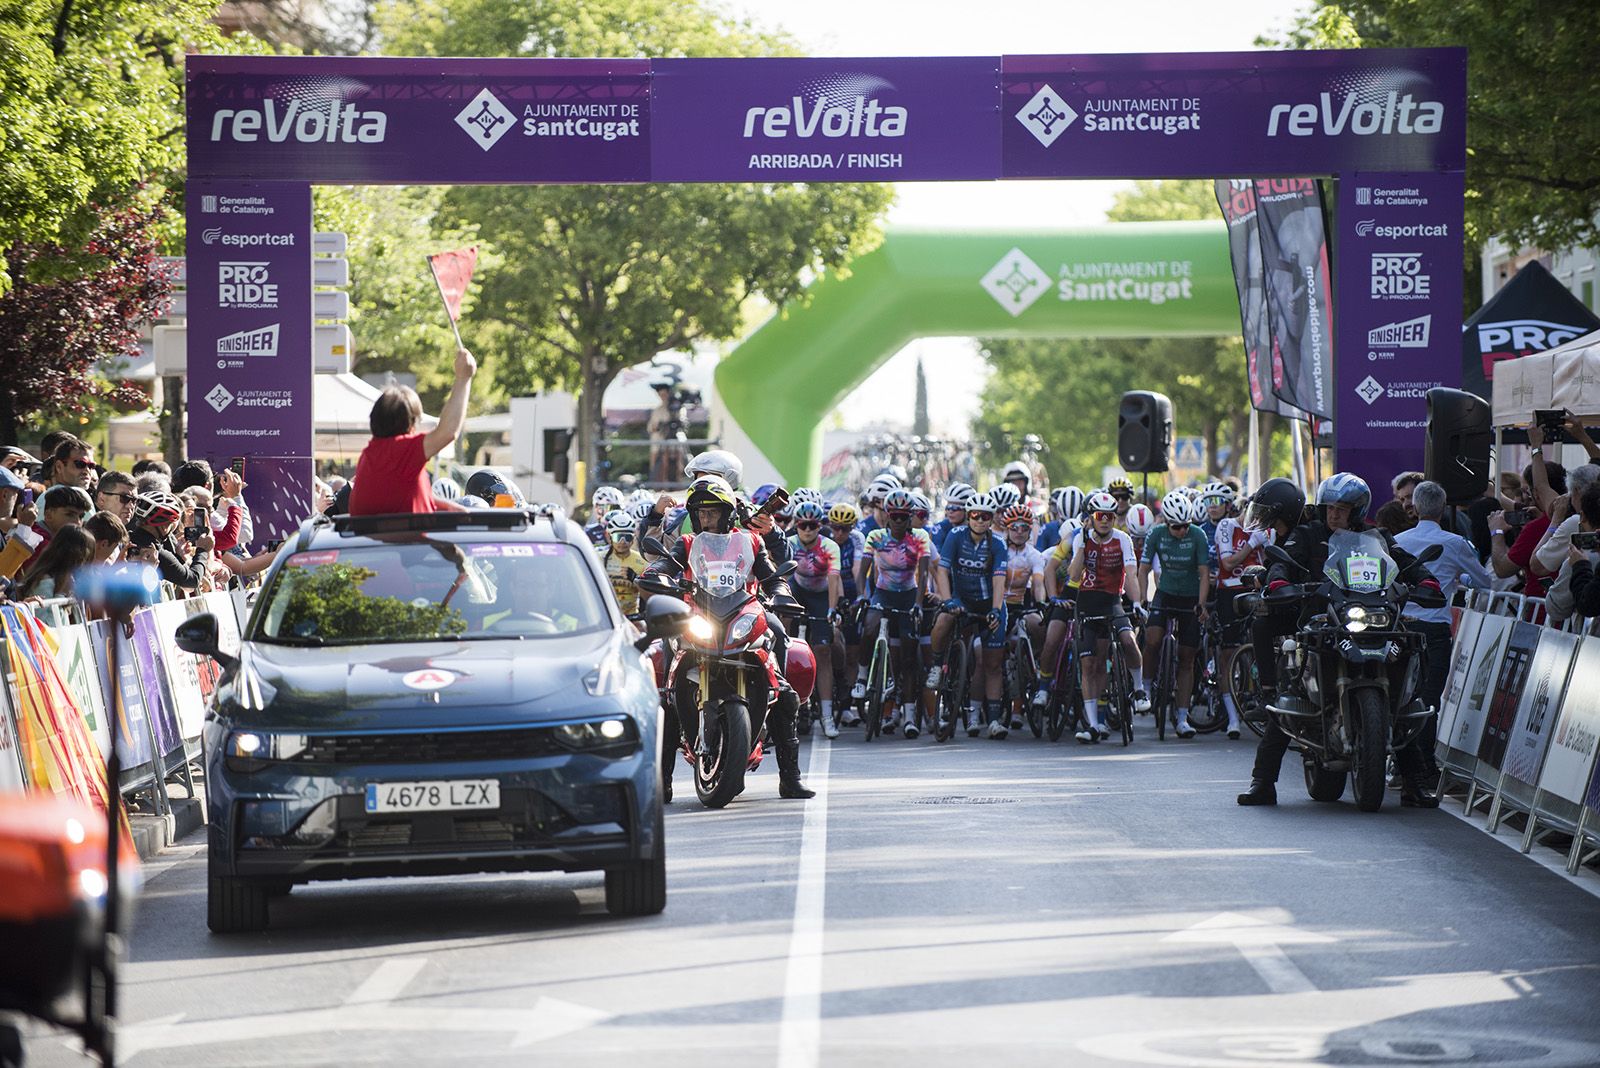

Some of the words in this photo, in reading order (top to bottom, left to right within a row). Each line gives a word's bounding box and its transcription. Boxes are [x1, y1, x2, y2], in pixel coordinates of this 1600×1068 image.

[523, 104, 617, 117] AJUNTAMENT
[621, 104, 639, 116] DE
[1084, 98, 1178, 112] AJUNTAMENT
[1182, 98, 1200, 110] DE
[210, 99, 387, 143] reVolta
[743, 96, 907, 138] reVolta
[1084, 112, 1200, 135] SantCugat
[1267, 92, 1444, 137] reVolta
[523, 117, 639, 142] SantCugat
[748, 154, 834, 169] ARRIBADA
[848, 153, 903, 168] FINISH
[220, 196, 265, 205] Generalitat
[1374, 188, 1419, 196] Generalitat
[232, 205, 274, 216] Catalunya
[1374, 197, 1384, 205] de
[1386, 197, 1428, 207] Catalunya
[221, 233, 295, 248] esportcat
[1375, 223, 1448, 240] esportcat
[219, 266, 269, 284] PRO
[1059, 262, 1168, 279] AJUNTAMENT
[1172, 261, 1193, 276] DE
[1371, 257, 1421, 275] PRO
[219, 284, 278, 303] RIDE
[1058, 278, 1193, 304] SantCugat
[1371, 275, 1431, 294] RIDE
[219, 331, 274, 351] FINISHER
[1370, 322, 1425, 343] FINISHER
[236, 397, 293, 408] SantCugat
[216, 428, 281, 437] visitsantcugat.cat
[719, 574, 735, 586] 96
[1362, 570, 1377, 582] 97
[386, 785, 441, 808] 4678
[450, 783, 491, 806] LZX
